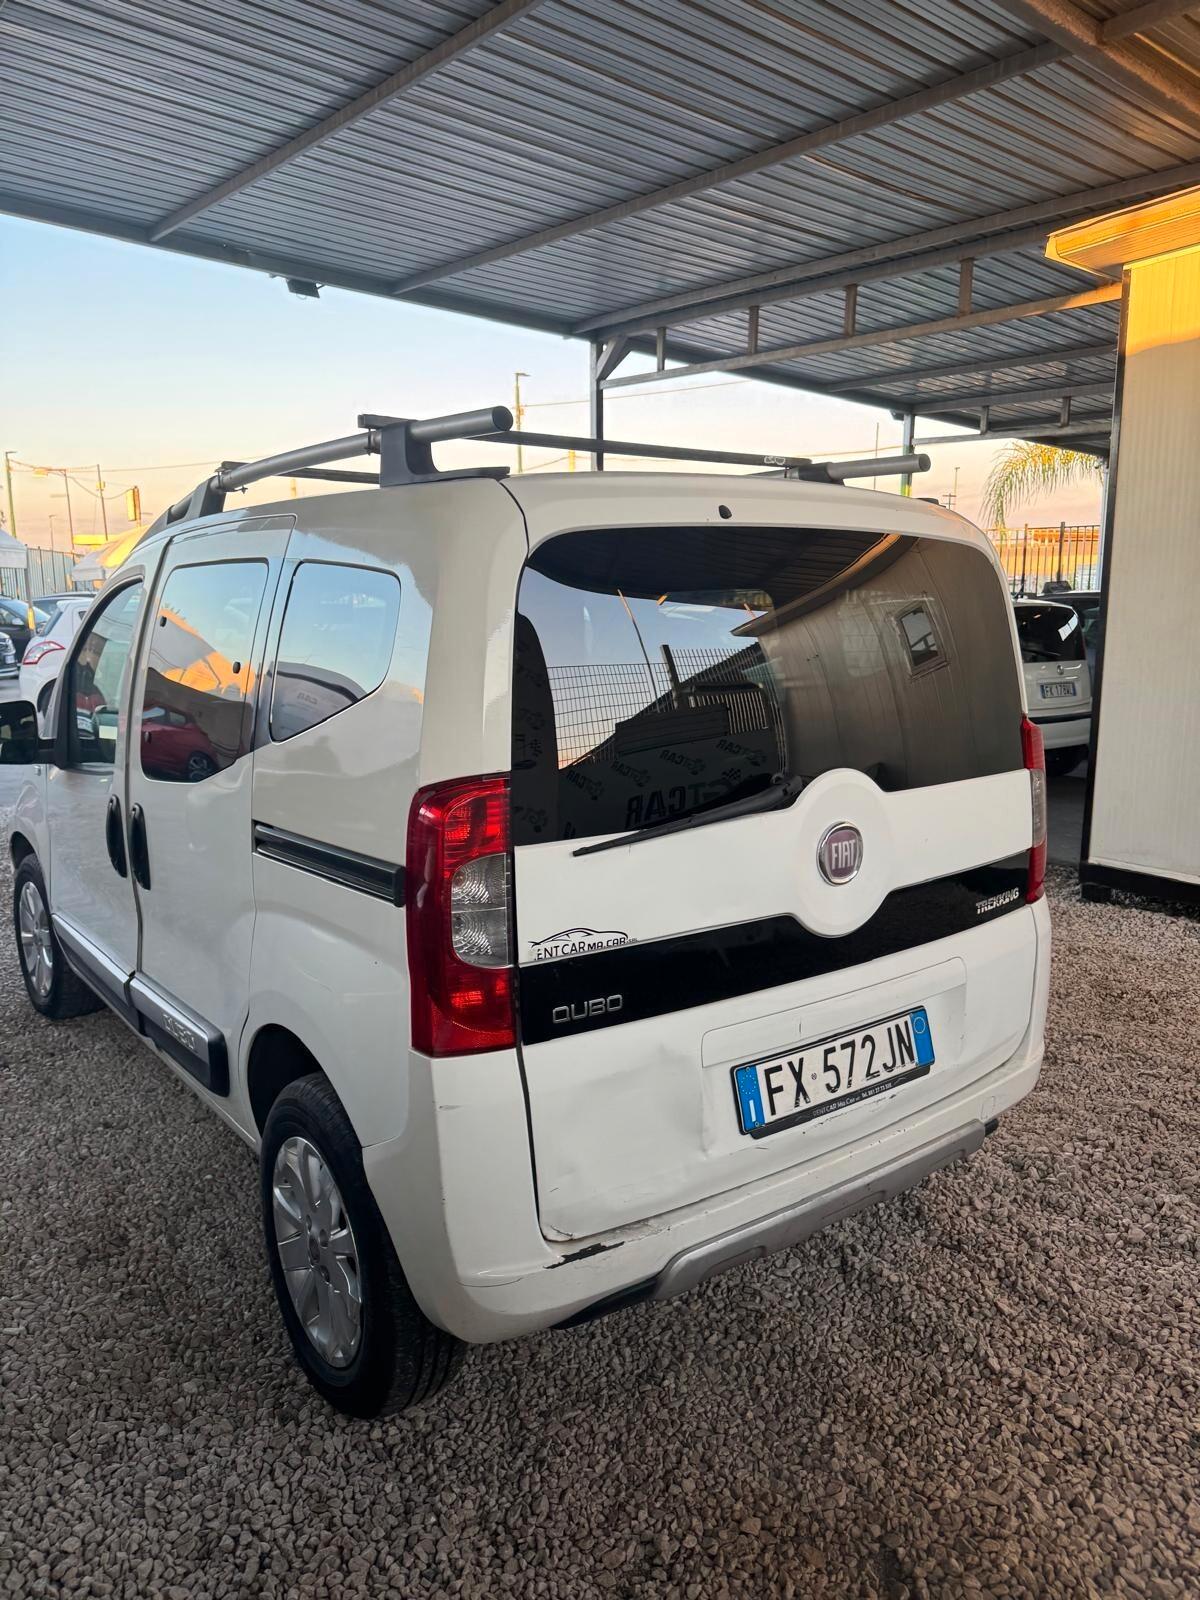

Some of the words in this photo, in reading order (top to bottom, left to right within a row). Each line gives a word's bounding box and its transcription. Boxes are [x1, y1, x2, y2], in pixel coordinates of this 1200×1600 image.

[831, 839, 856, 870] FIAT
[975, 887, 1020, 915] TREKKING
[552, 994, 623, 1024] QUBO
[749, 1099, 757, 1122] I
[764, 1057, 810, 1116] FX
[823, 1021, 915, 1094] 572JN
